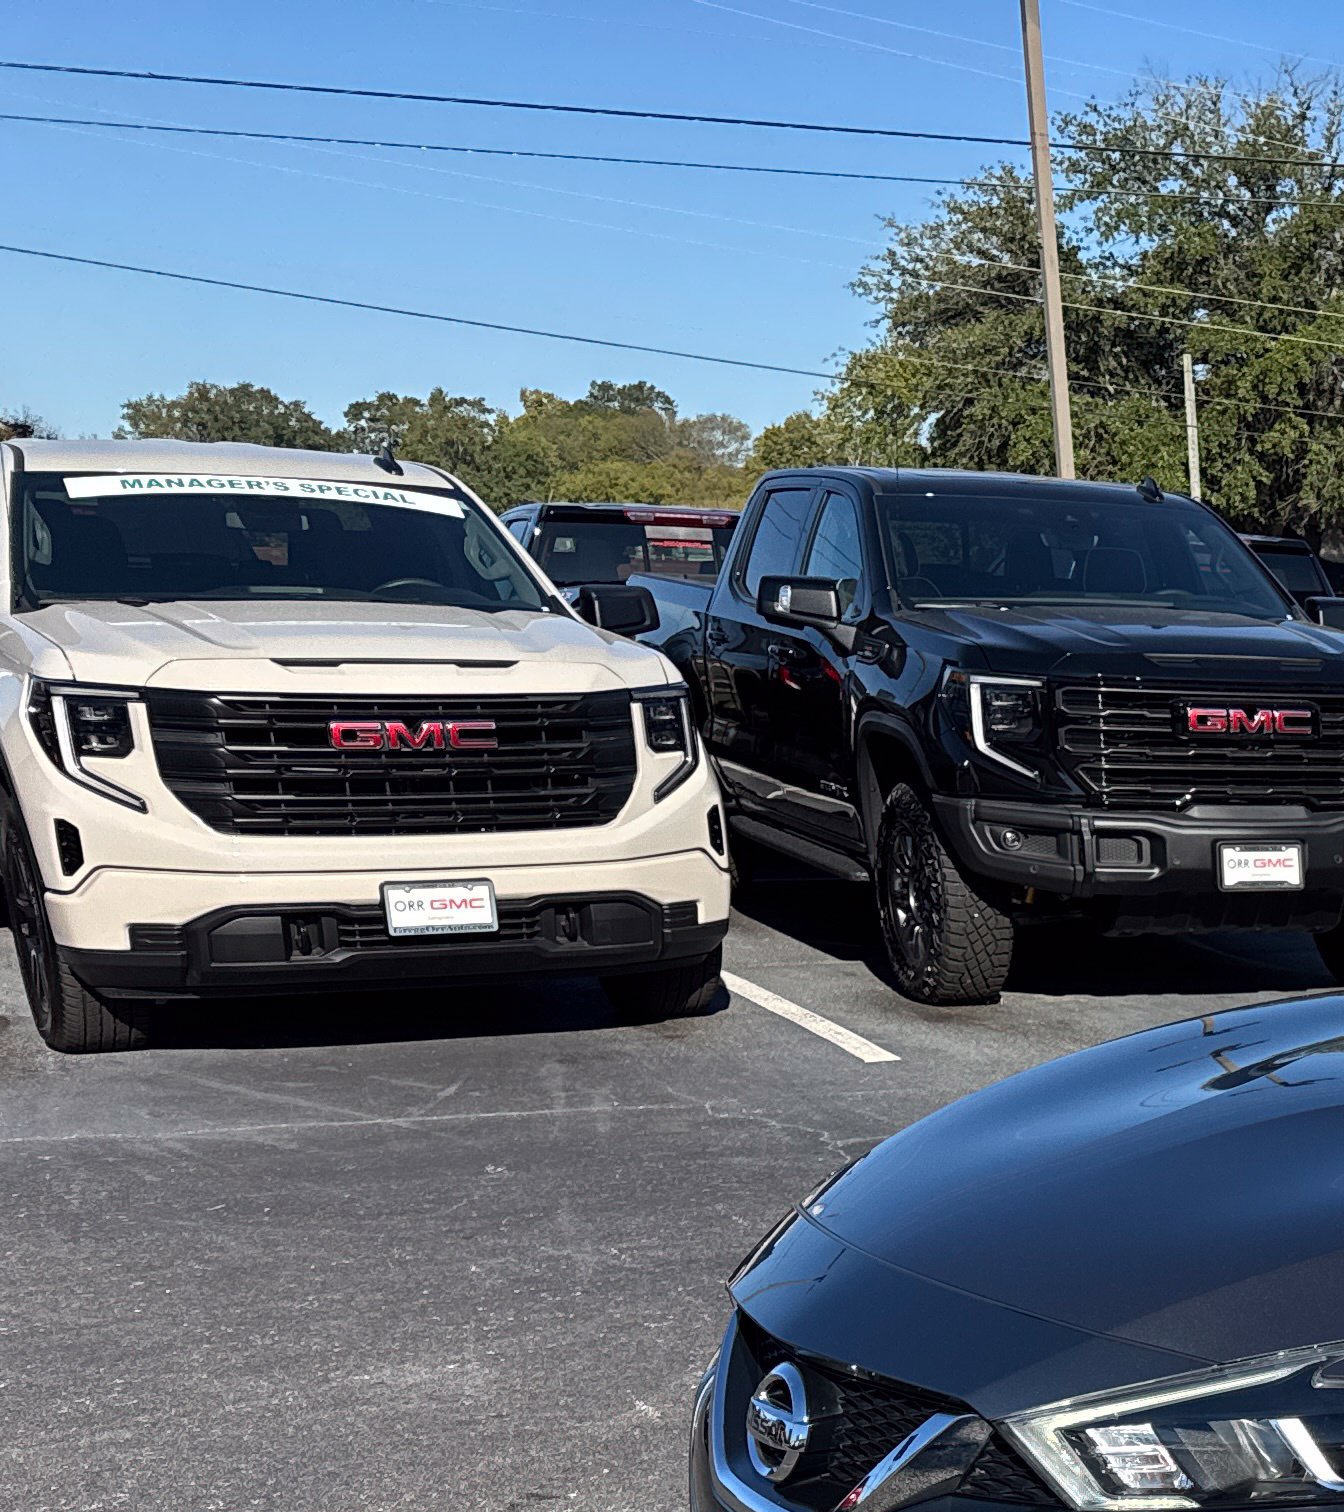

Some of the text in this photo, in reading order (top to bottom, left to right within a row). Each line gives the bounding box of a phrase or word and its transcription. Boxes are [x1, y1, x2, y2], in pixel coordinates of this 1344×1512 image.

[120, 478, 416, 505] MANAGER'S SPECIAL
[1187, 706, 1312, 734] GMC
[328, 720, 498, 750] GMC
[1227, 857, 1295, 869] ORR GMC
[394, 898, 485, 912] ORR GMC
